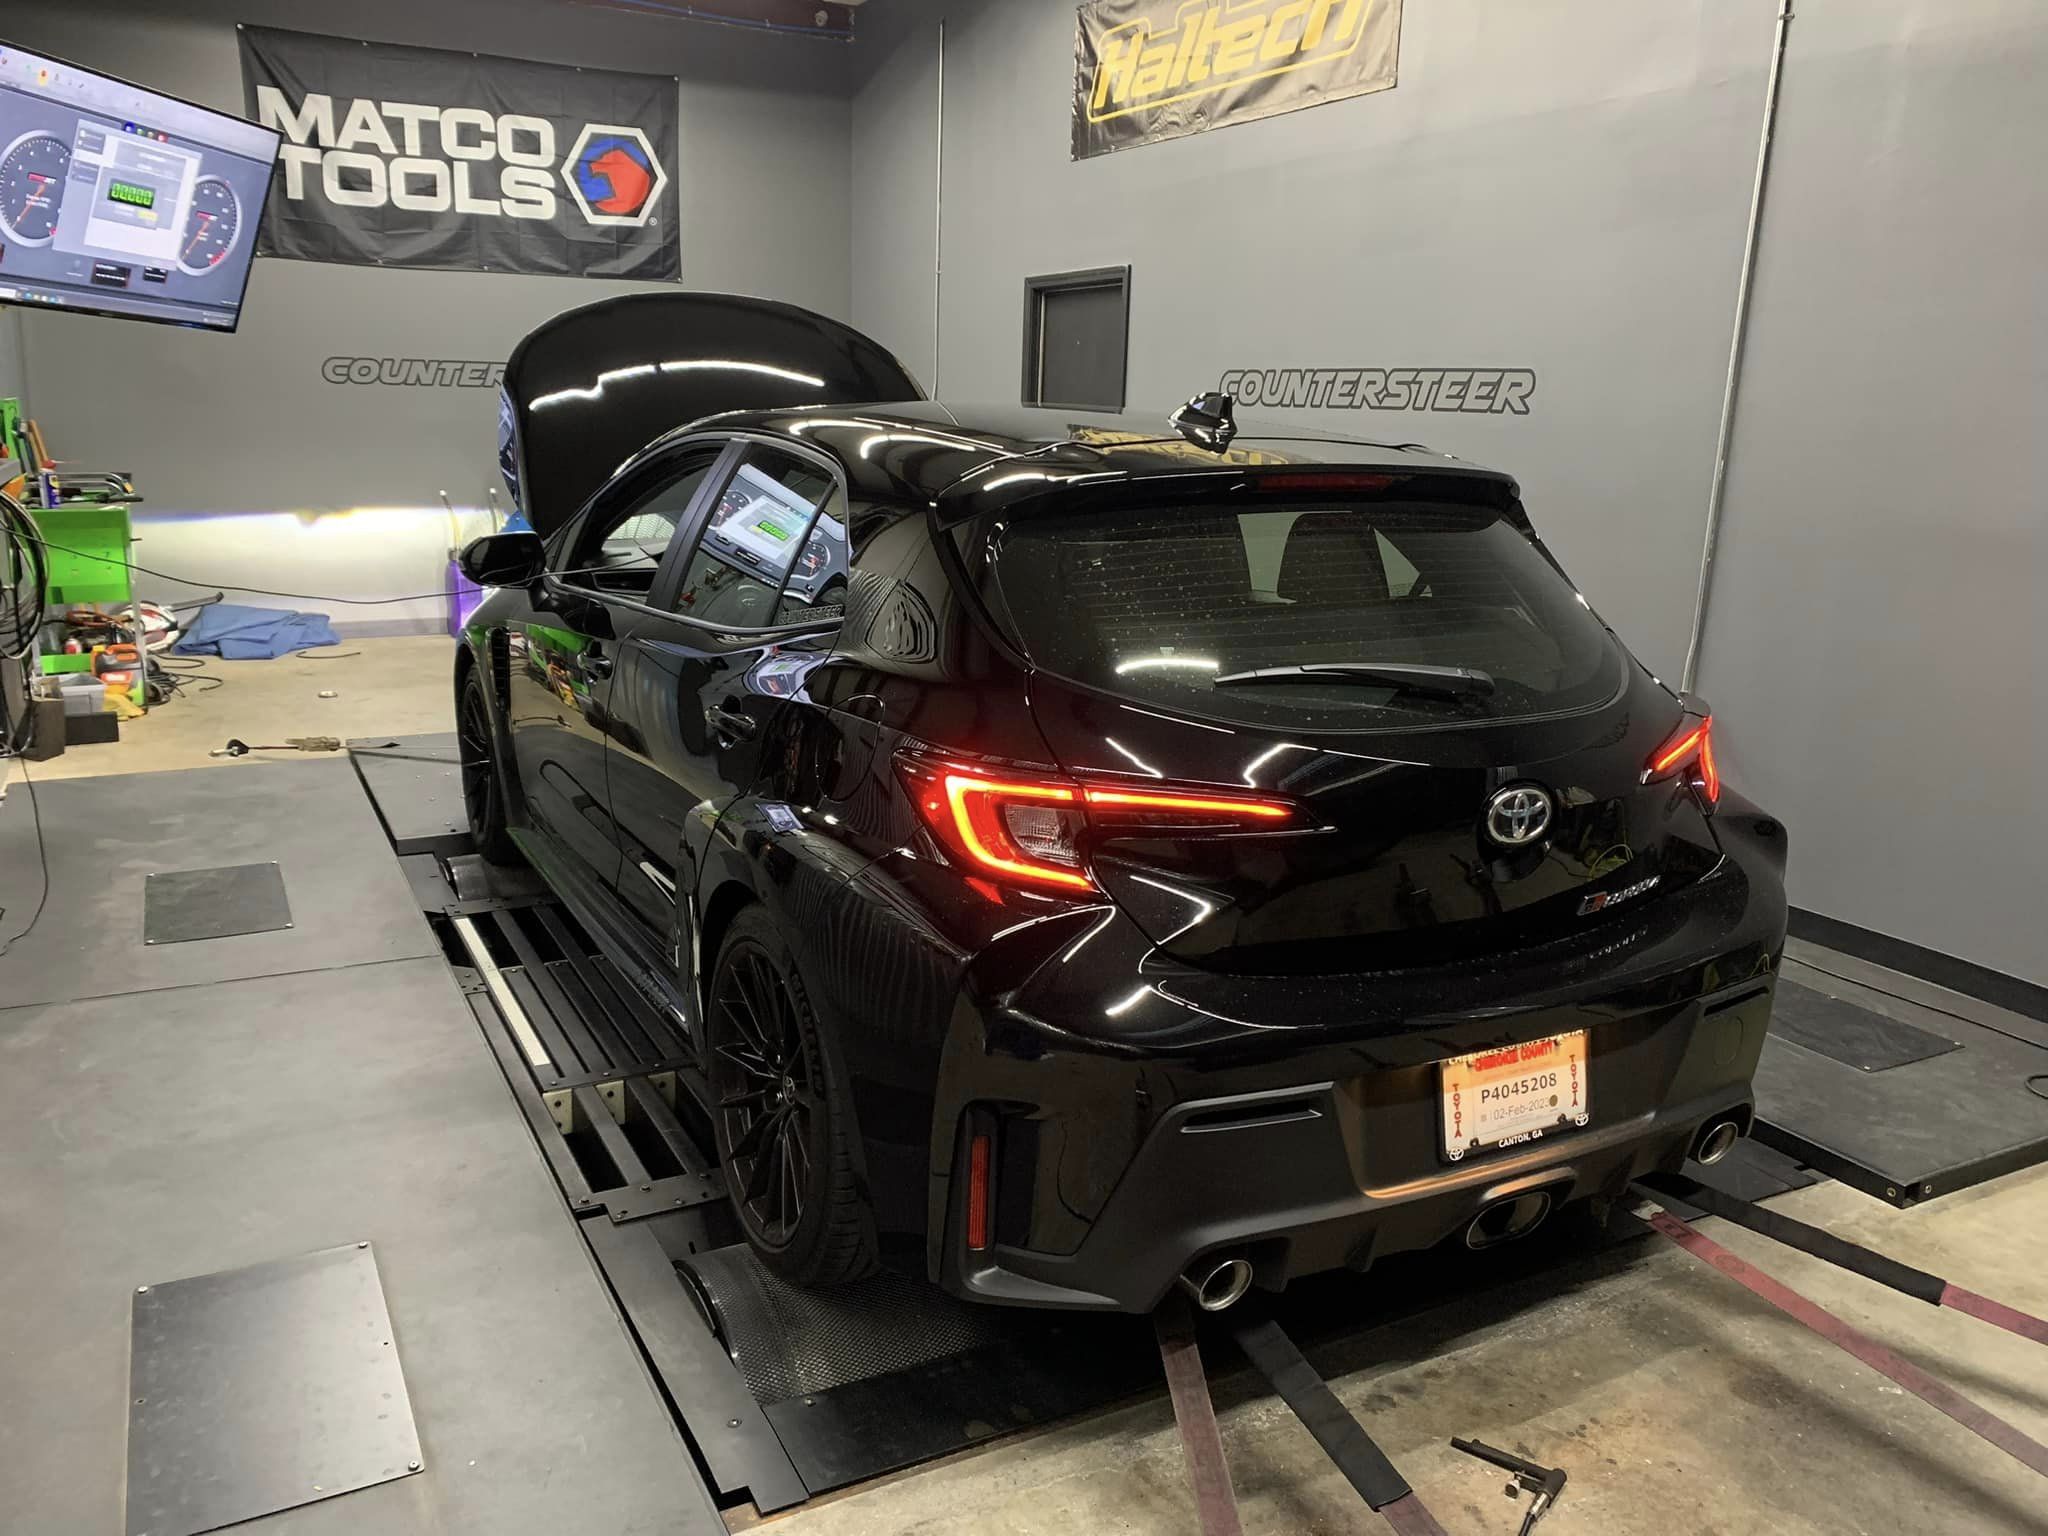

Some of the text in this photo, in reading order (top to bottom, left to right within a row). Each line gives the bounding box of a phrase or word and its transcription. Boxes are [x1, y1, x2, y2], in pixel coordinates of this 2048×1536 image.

[1093, 0, 1364, 109] Haltech
[256, 85, 556, 168] MATCO
[278, 143, 556, 220] TOOLS
[1219, 368, 1536, 415] COUNTERSTEER
[1481, 1072, 1557, 1104] P4045208
[1568, 1054, 1578, 1108] TOYOTA
[1452, 1083, 1462, 1139] TOYOTA
[1532, 1129, 1544, 1139] GA
